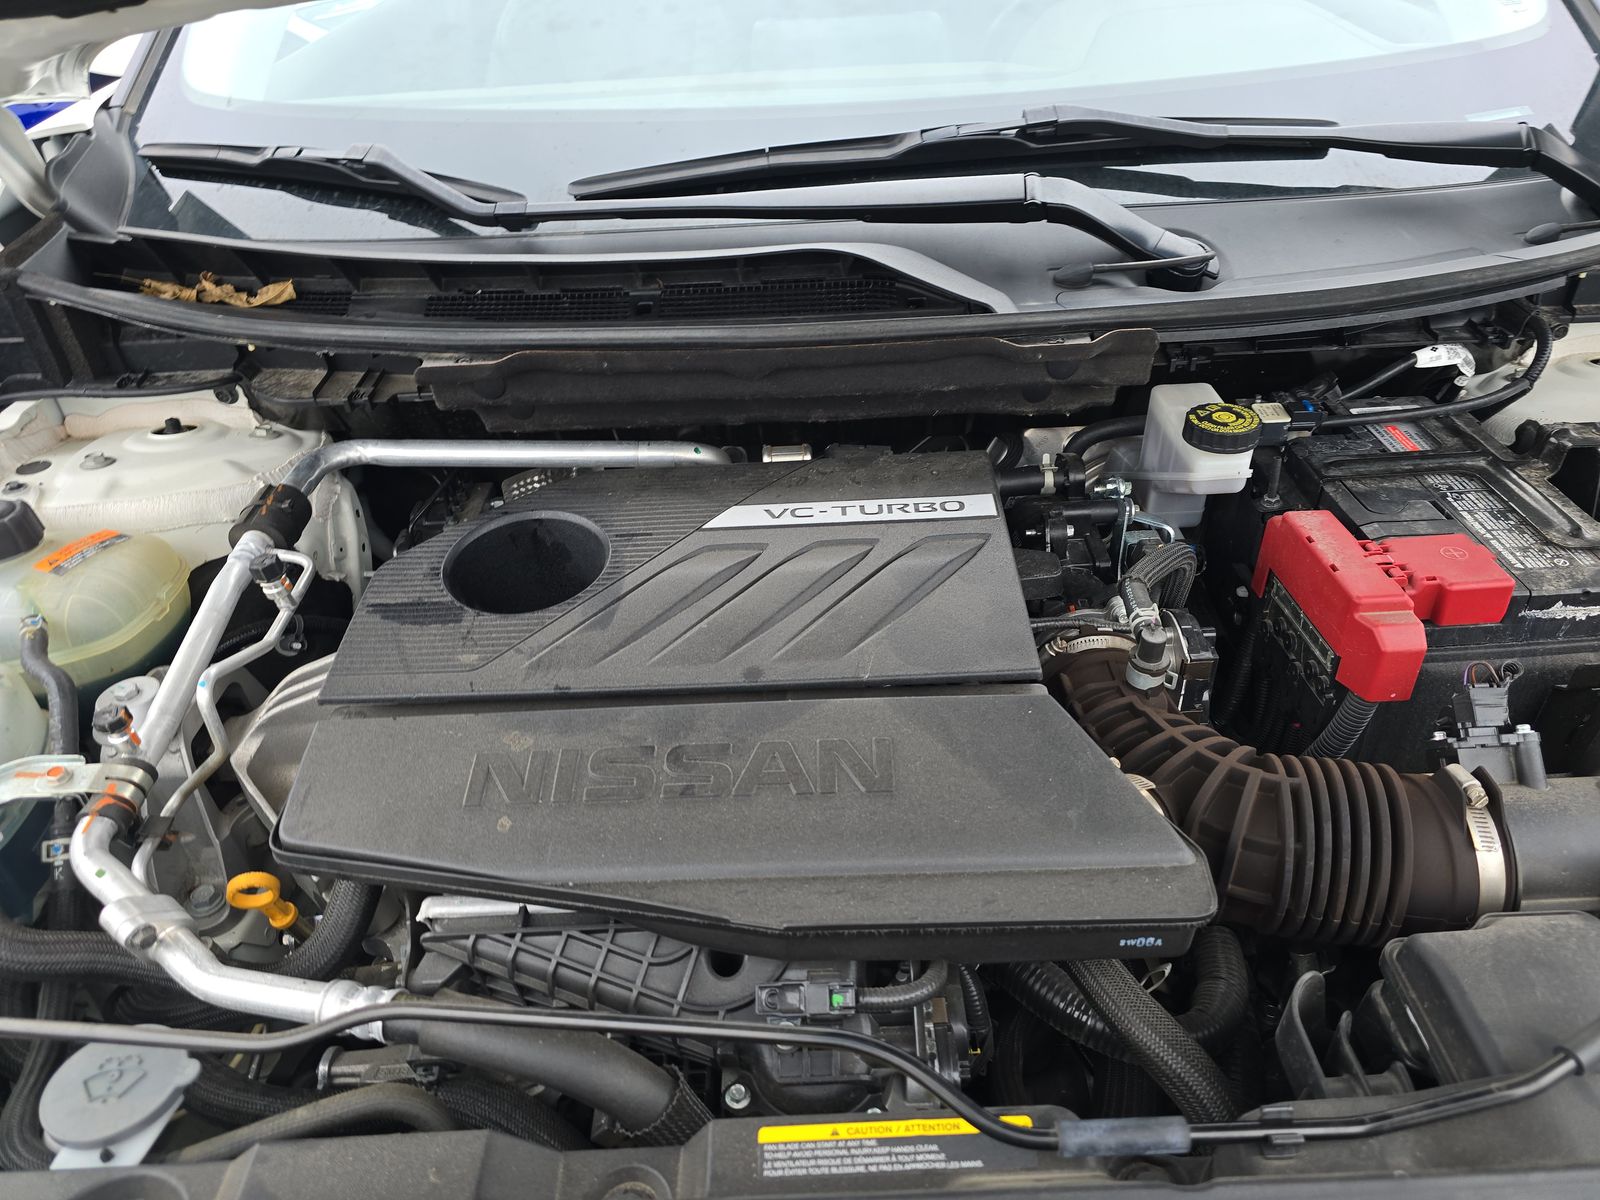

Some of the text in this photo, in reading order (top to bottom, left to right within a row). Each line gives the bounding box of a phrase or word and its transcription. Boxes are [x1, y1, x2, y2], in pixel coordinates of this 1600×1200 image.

[763, 500, 966, 520] VC-TURBO
[462, 737, 895, 807] NISSAN
[846, 1124, 892, 1136] CAUTION
[904, 1122, 961, 1132] ATTENTION
[778, 1142, 799, 1150] BLADE
[792, 1150, 813, 1158] AVOID
[814, 1149, 848, 1157] PERSONAL
[774, 1159, 816, 1168] VENTILATEUR
[817, 1158, 842, 1166] RISQUE
[898, 1154, 914, 1162] TOUT
[763, 1169, 783, 1177] POUR
[808, 1167, 829, 1175] TOUTE
[879, 1164, 892, 1172] PAS
[904, 1161, 946, 1170] APPROCHER
